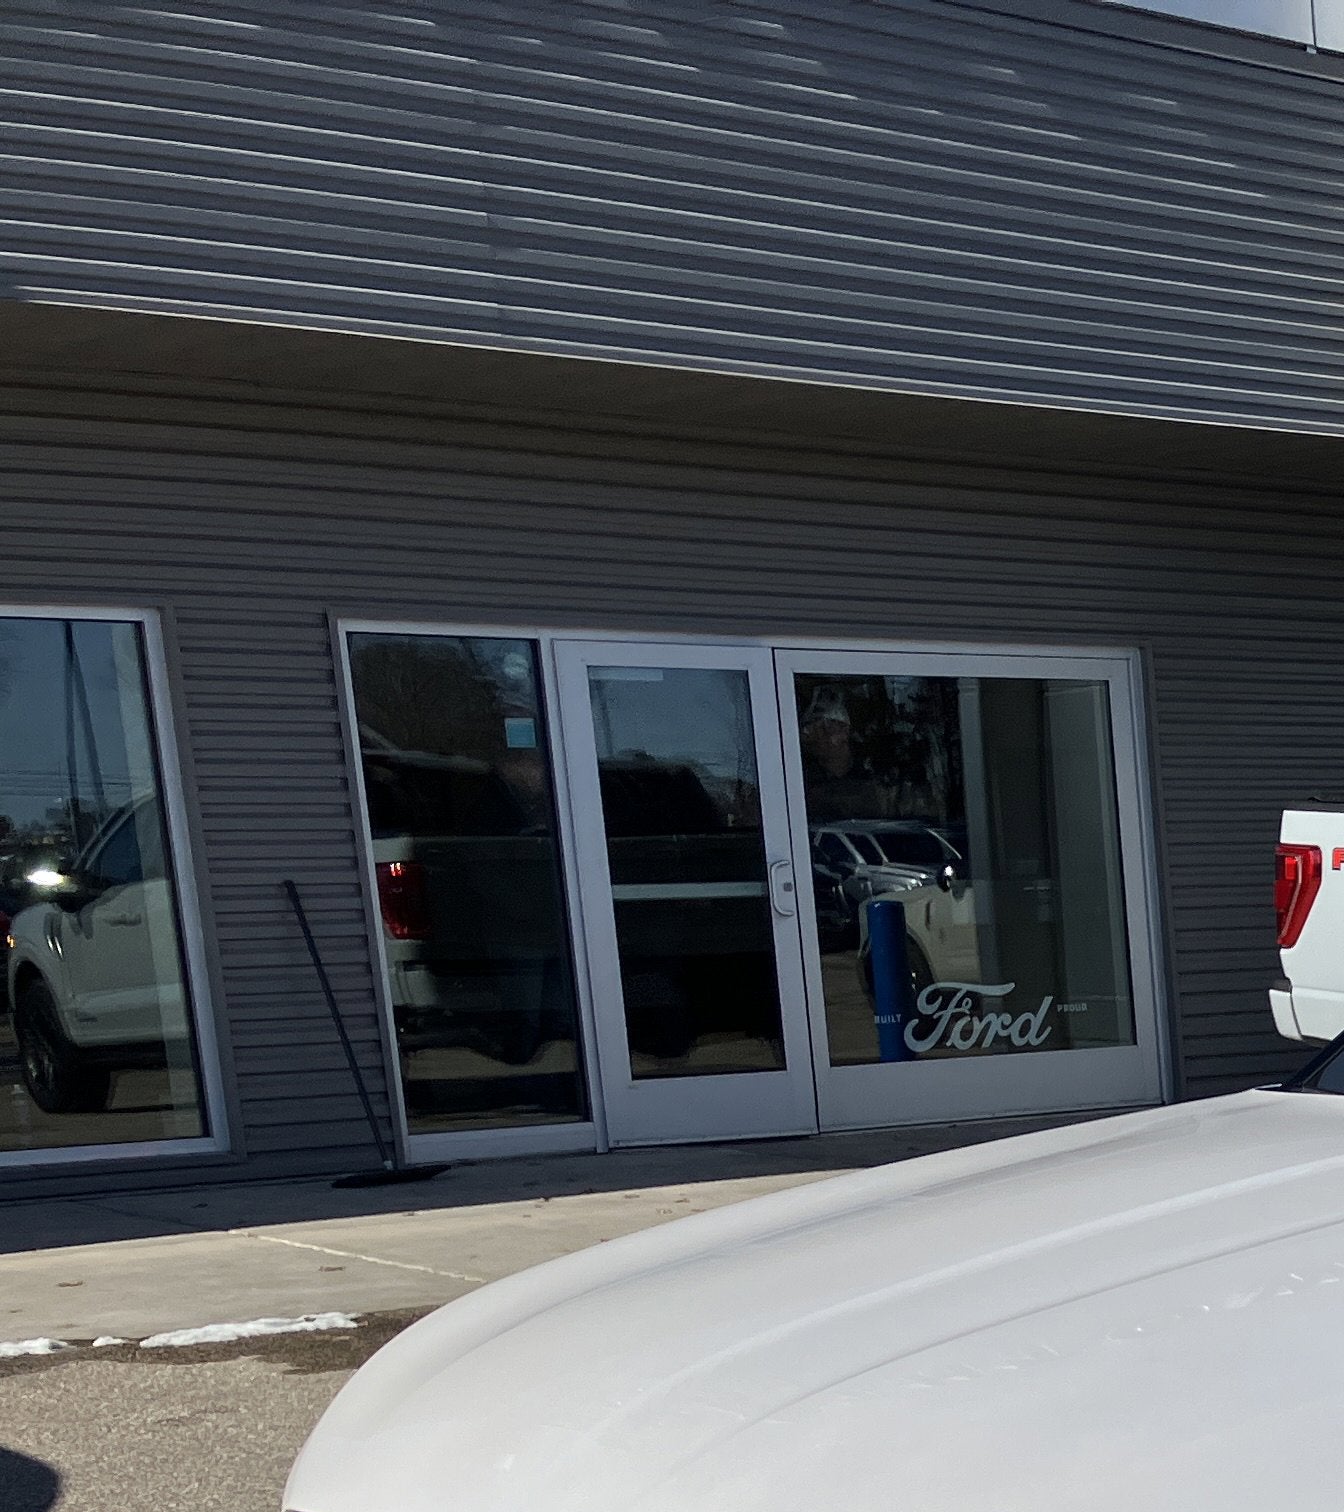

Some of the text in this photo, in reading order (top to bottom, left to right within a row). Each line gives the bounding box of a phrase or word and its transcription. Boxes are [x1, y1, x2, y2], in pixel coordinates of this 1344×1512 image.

[874, 981, 1088, 1053] BUILT Ford PROUD
